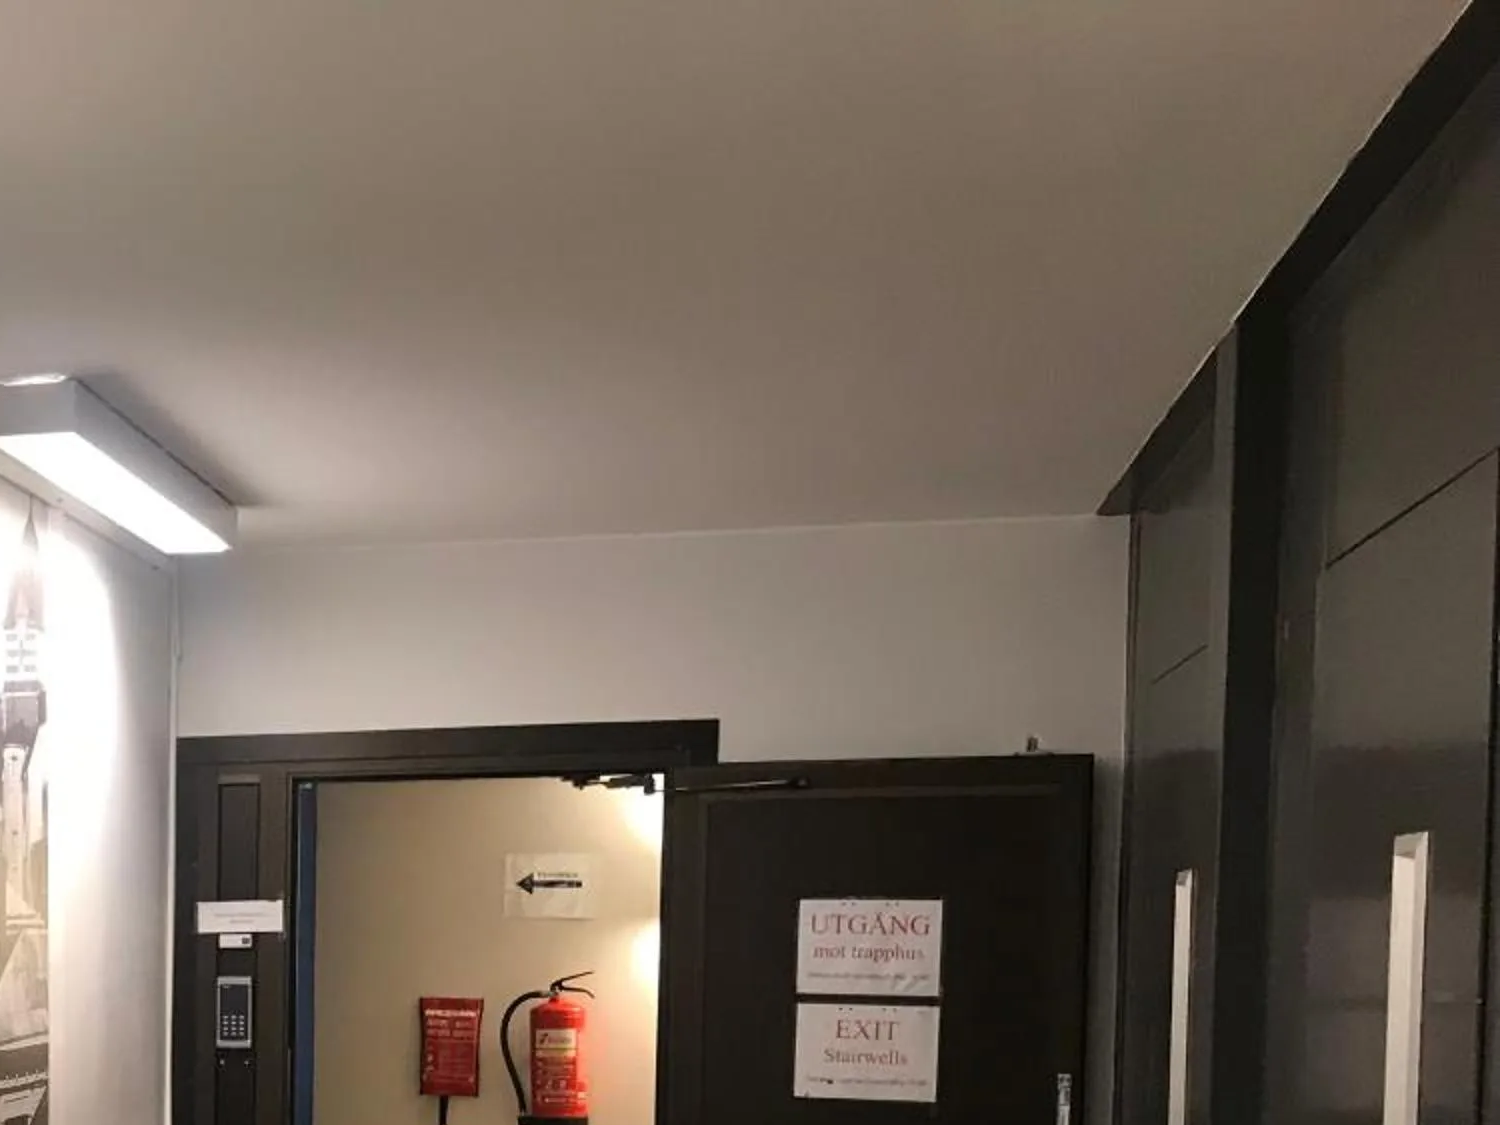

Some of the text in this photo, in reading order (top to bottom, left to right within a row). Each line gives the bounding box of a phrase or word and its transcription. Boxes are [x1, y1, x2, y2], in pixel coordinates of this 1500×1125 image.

[810, 911, 930, 936] UTGÅNG
[812, 944, 925, 964] mot trapphus
[835, 1018, 901, 1041] EXIT
[823, 1047, 908, 1066] Stairwells
